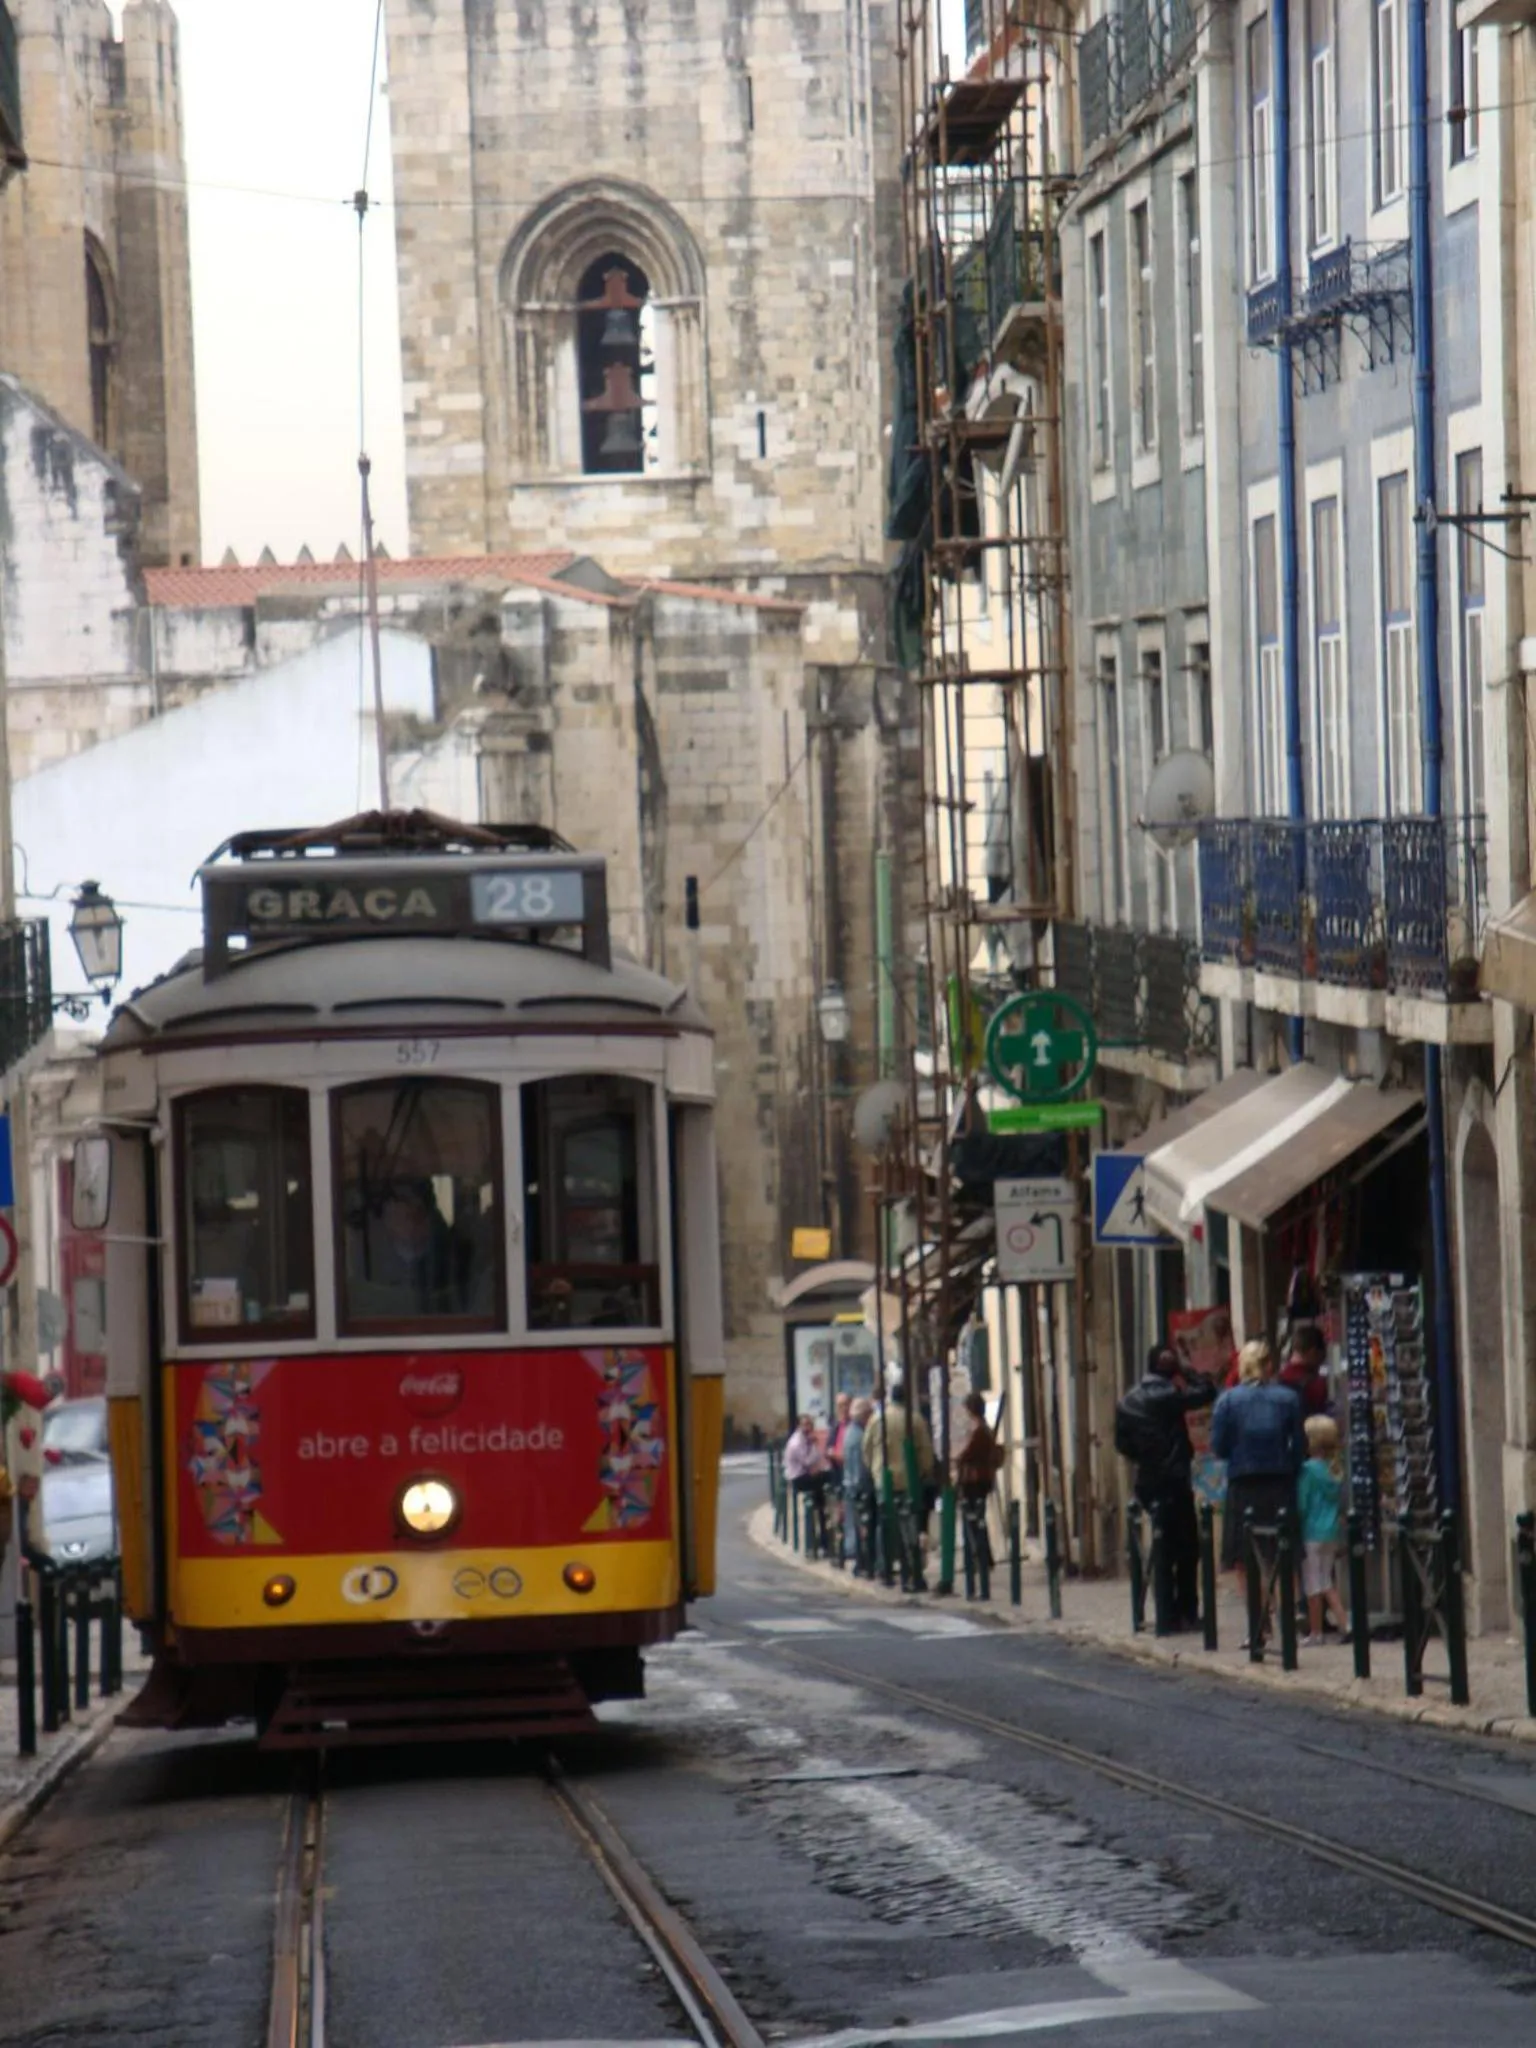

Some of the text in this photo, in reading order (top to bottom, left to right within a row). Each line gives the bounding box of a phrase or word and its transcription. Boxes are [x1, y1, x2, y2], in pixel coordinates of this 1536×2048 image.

[485, 875, 554, 920] 28
[396, 1040, 441, 1064] 557
[1009, 1185, 1062, 1199] Alfama
[297, 1420, 565, 1460] abre a felicidade
